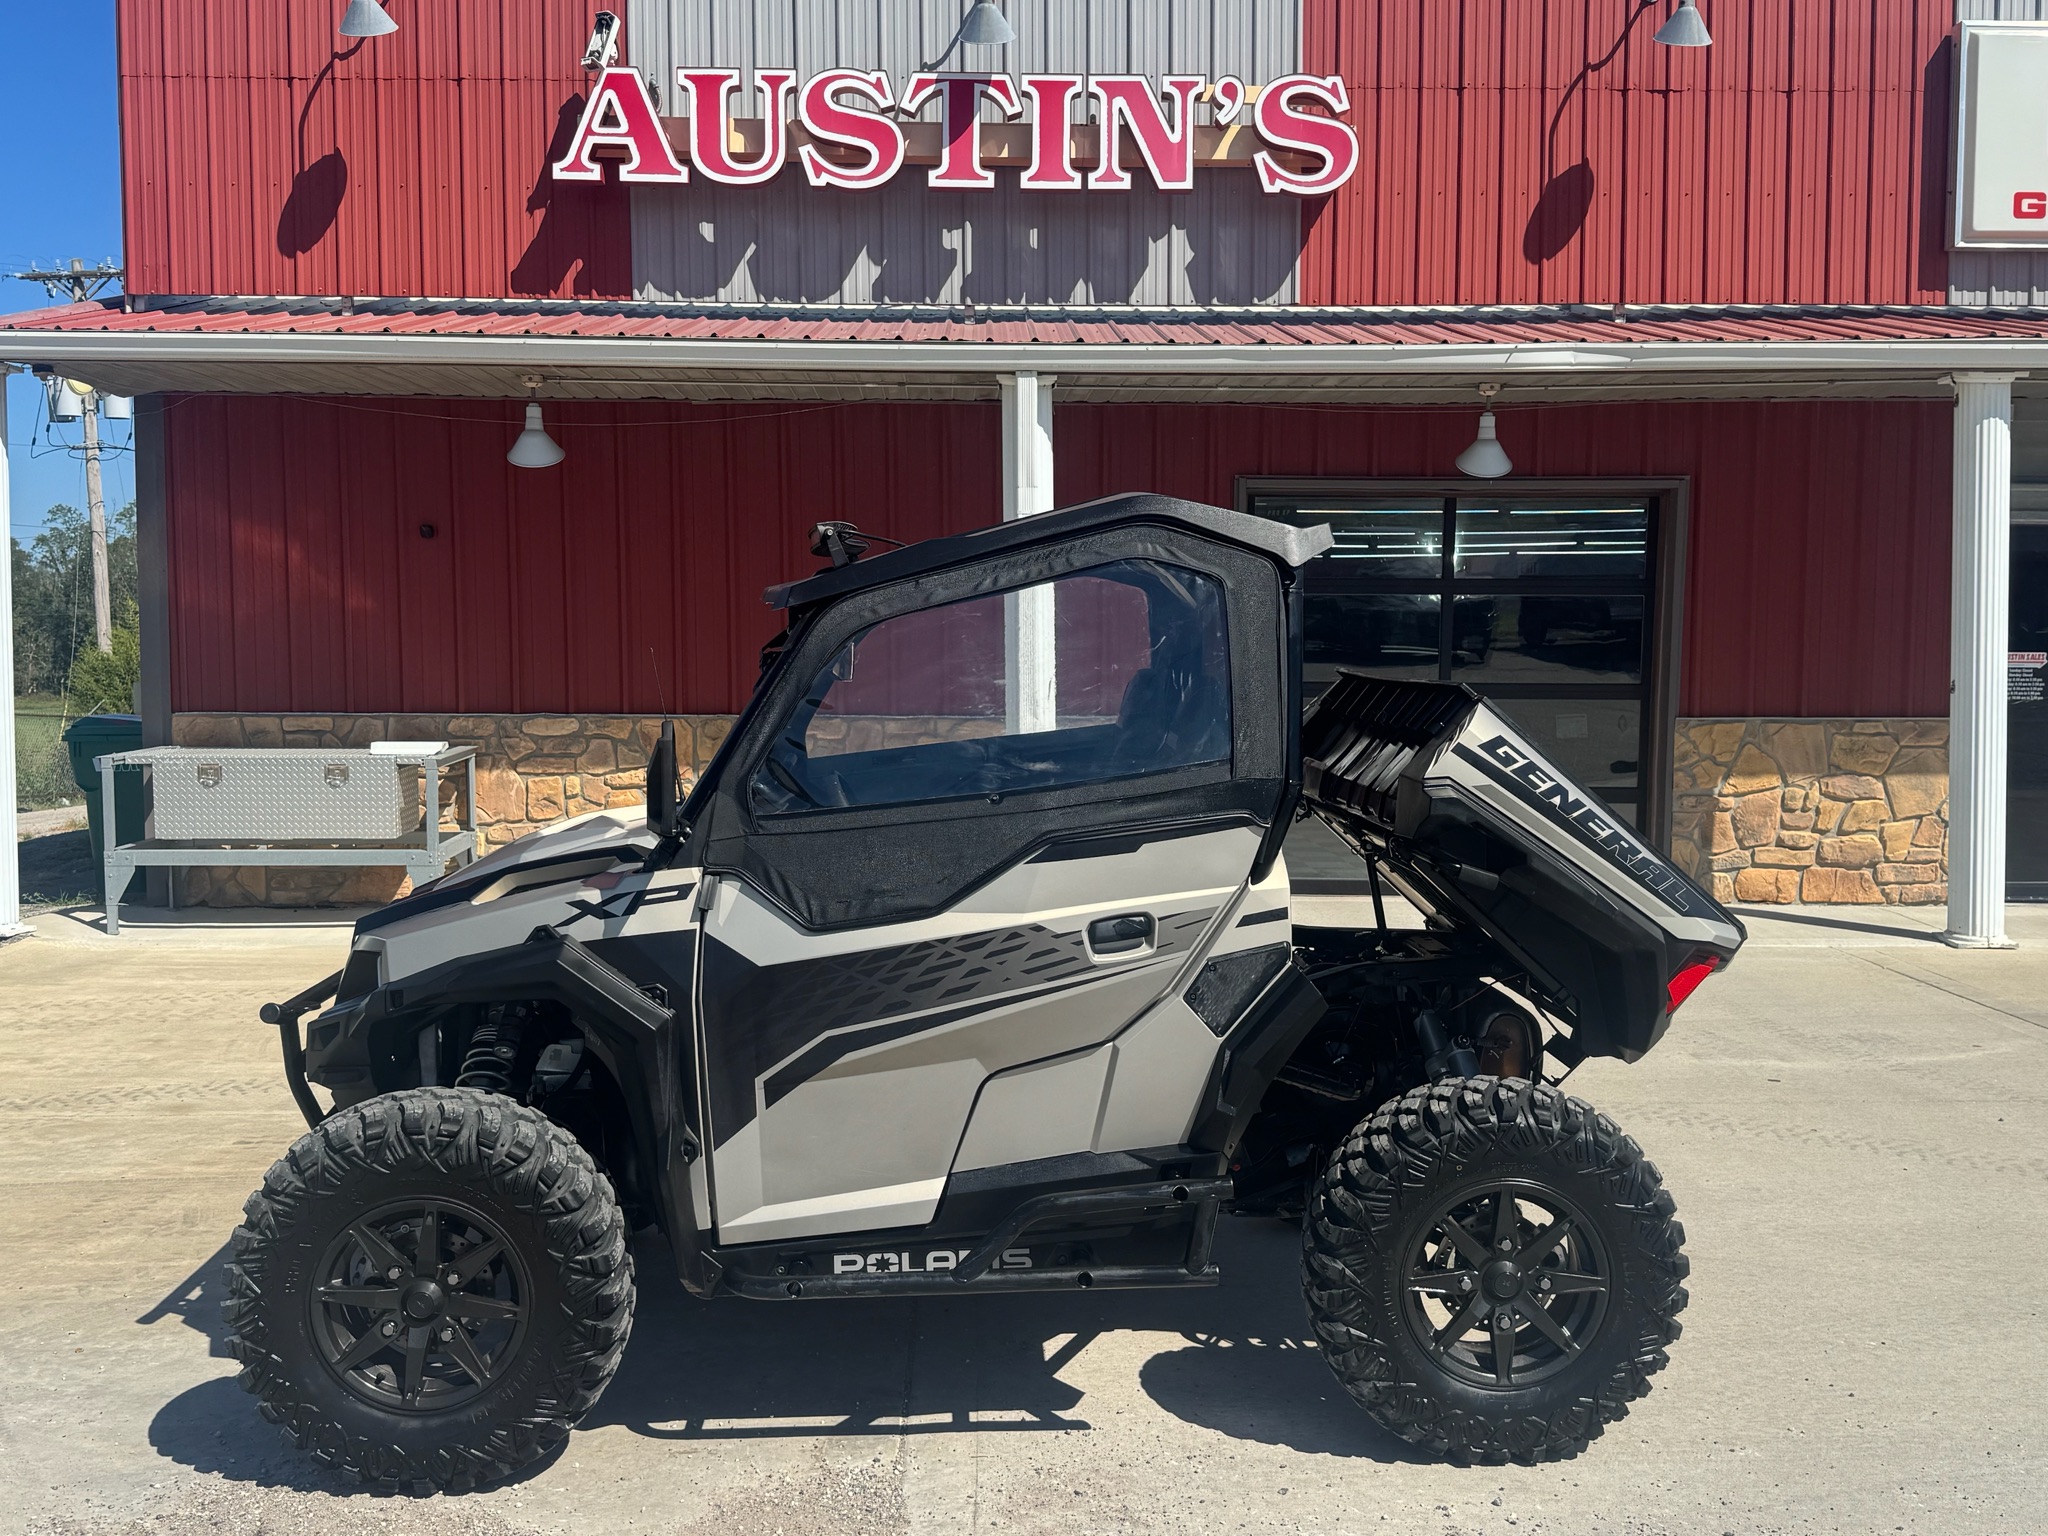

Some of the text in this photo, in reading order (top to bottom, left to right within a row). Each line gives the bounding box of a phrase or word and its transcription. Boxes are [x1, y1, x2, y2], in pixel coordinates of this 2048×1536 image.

[552, 67, 1361, 196] AUSTIN'S
[1477, 734, 1690, 912] GENERAL
[553, 882, 698, 928] XP
[833, 1248, 1033, 1275] POLAIS
